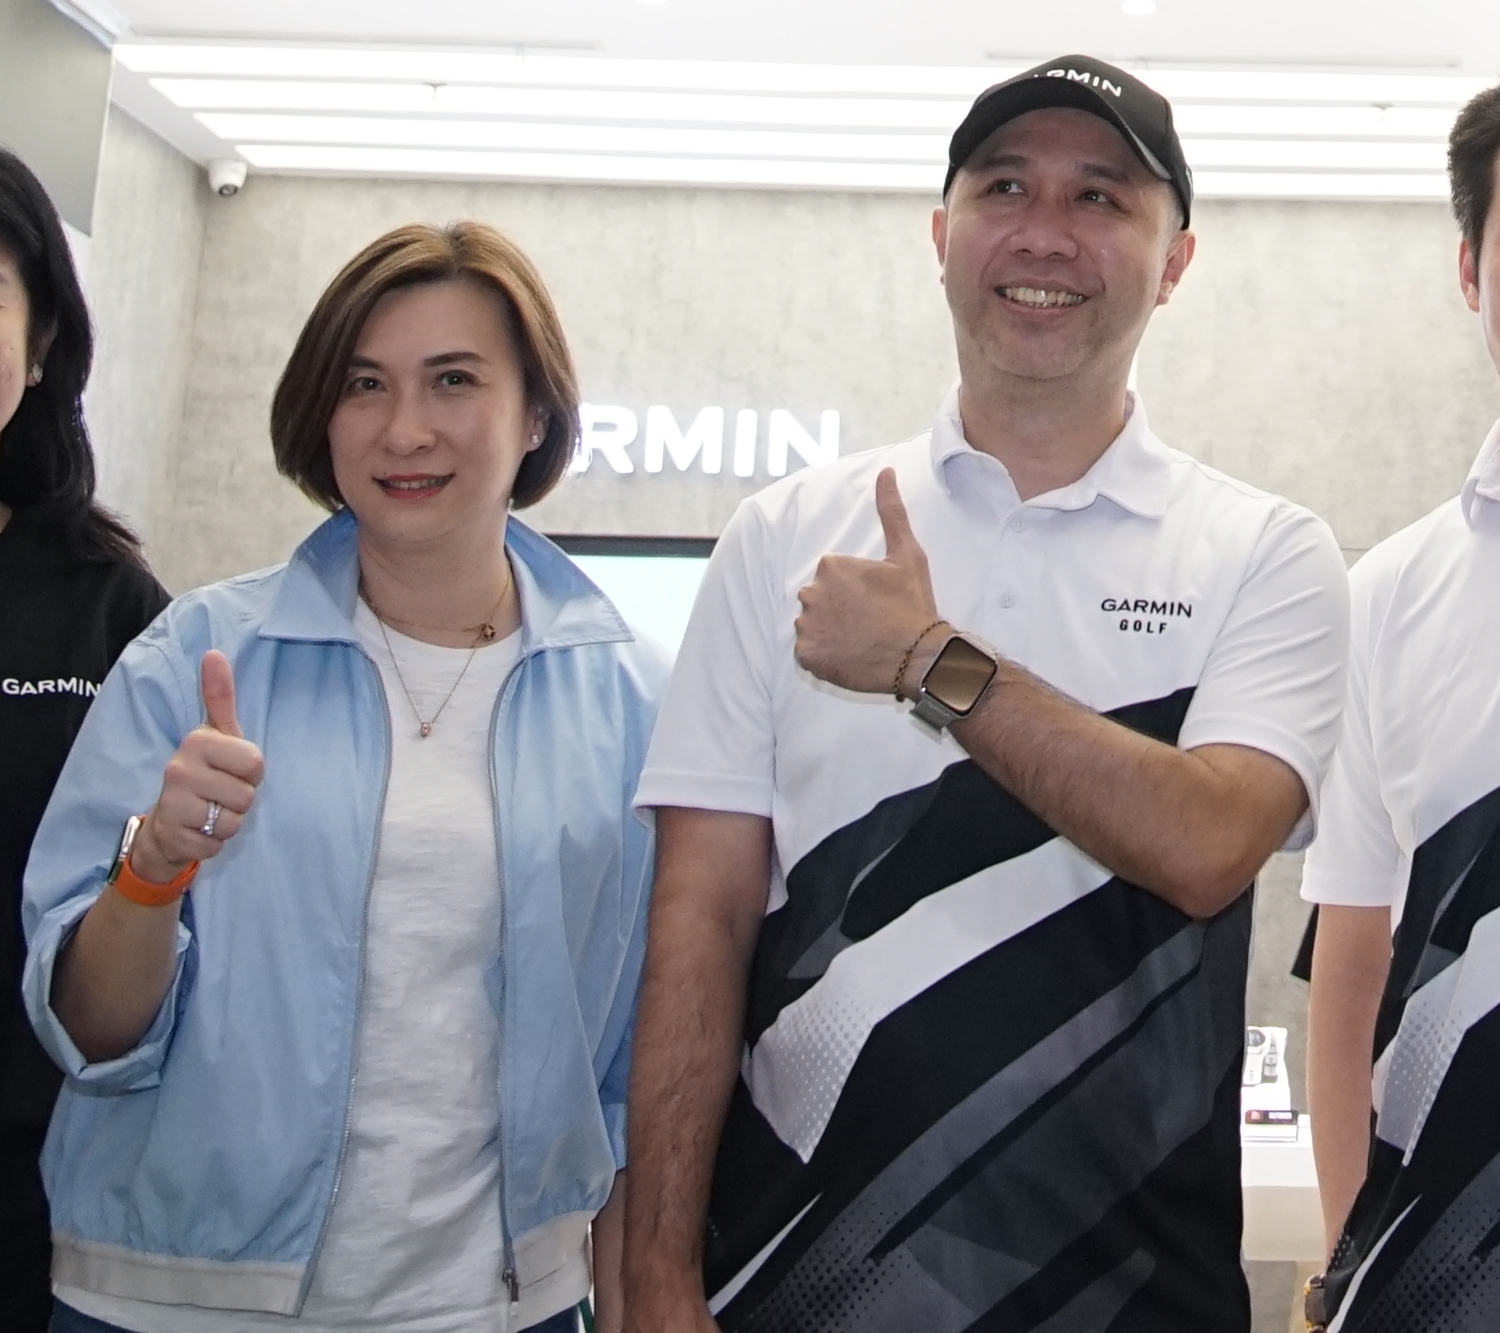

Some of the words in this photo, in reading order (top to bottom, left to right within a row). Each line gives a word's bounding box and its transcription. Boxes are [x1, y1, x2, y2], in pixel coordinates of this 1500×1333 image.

[569, 402, 841, 478] RMIN
[1101, 598, 1192, 618] GARMIN
[1119, 619, 1167, 634] GOLF
[2, 677, 102, 697] GARMIN
